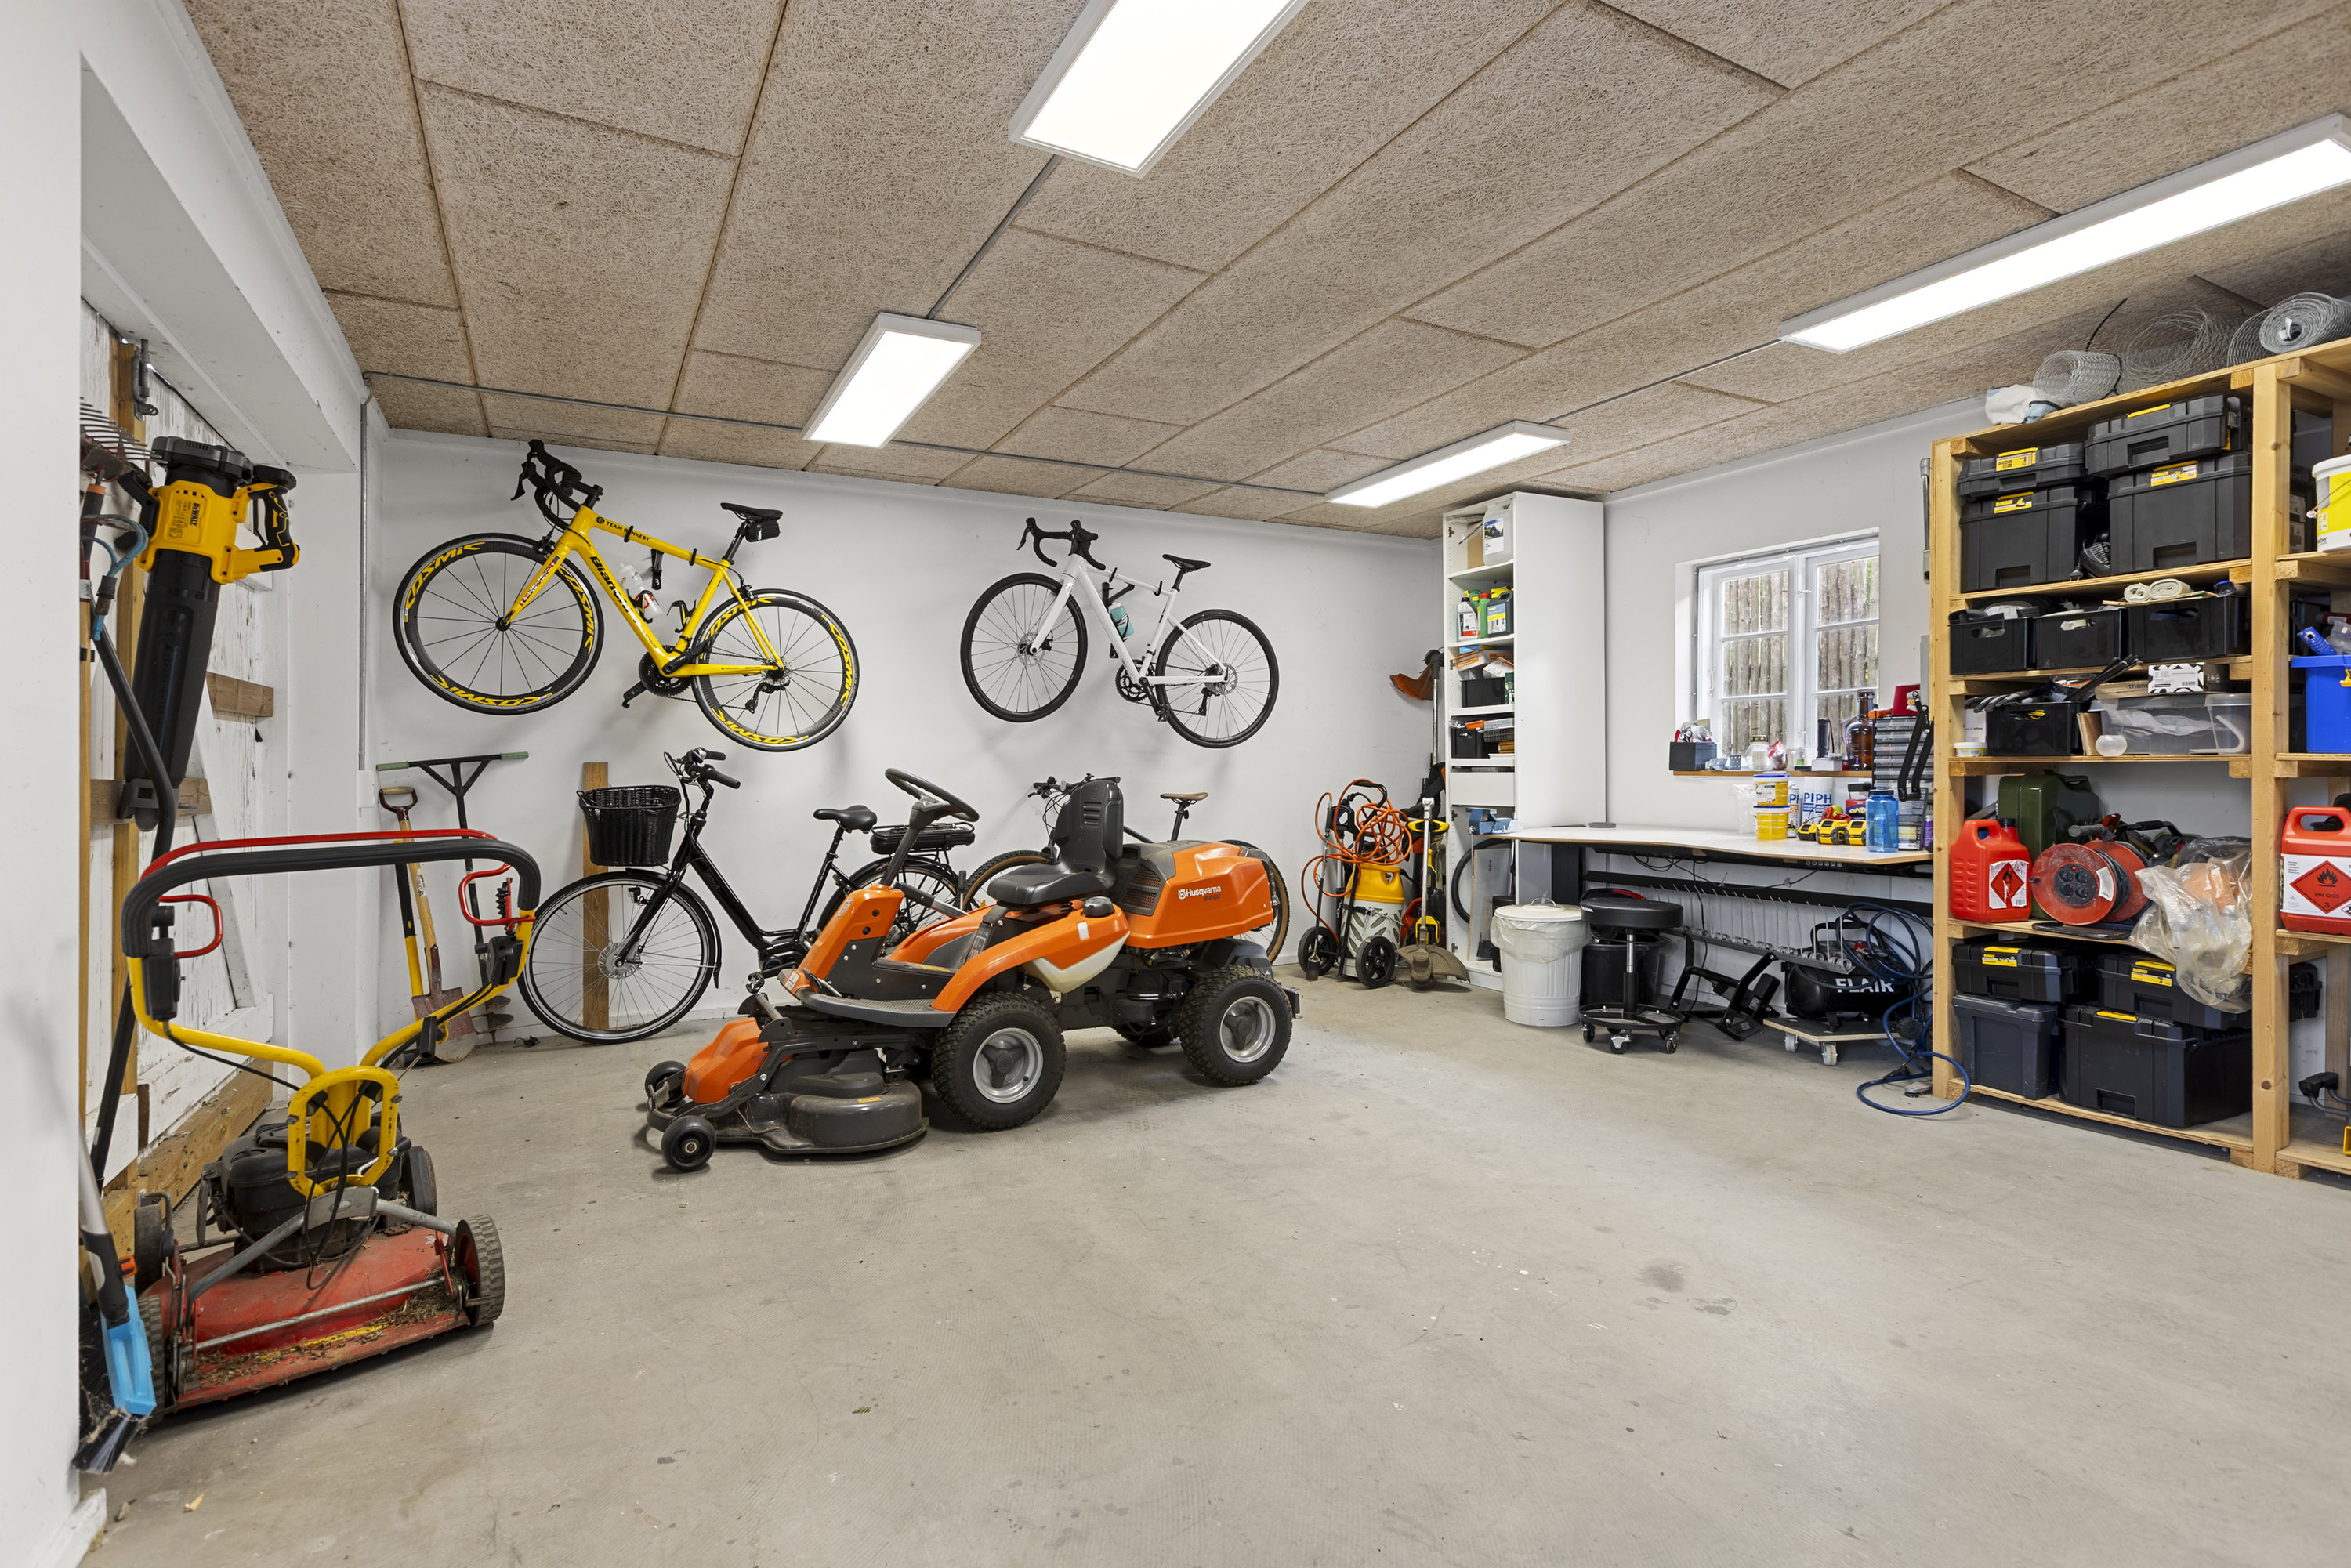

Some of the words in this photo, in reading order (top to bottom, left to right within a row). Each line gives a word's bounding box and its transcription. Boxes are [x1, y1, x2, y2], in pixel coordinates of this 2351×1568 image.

[607, 520, 623, 531] TEAM
[624, 527, 650, 541] RNKEBY
[1186, 885, 1222, 897] Husqvarna
